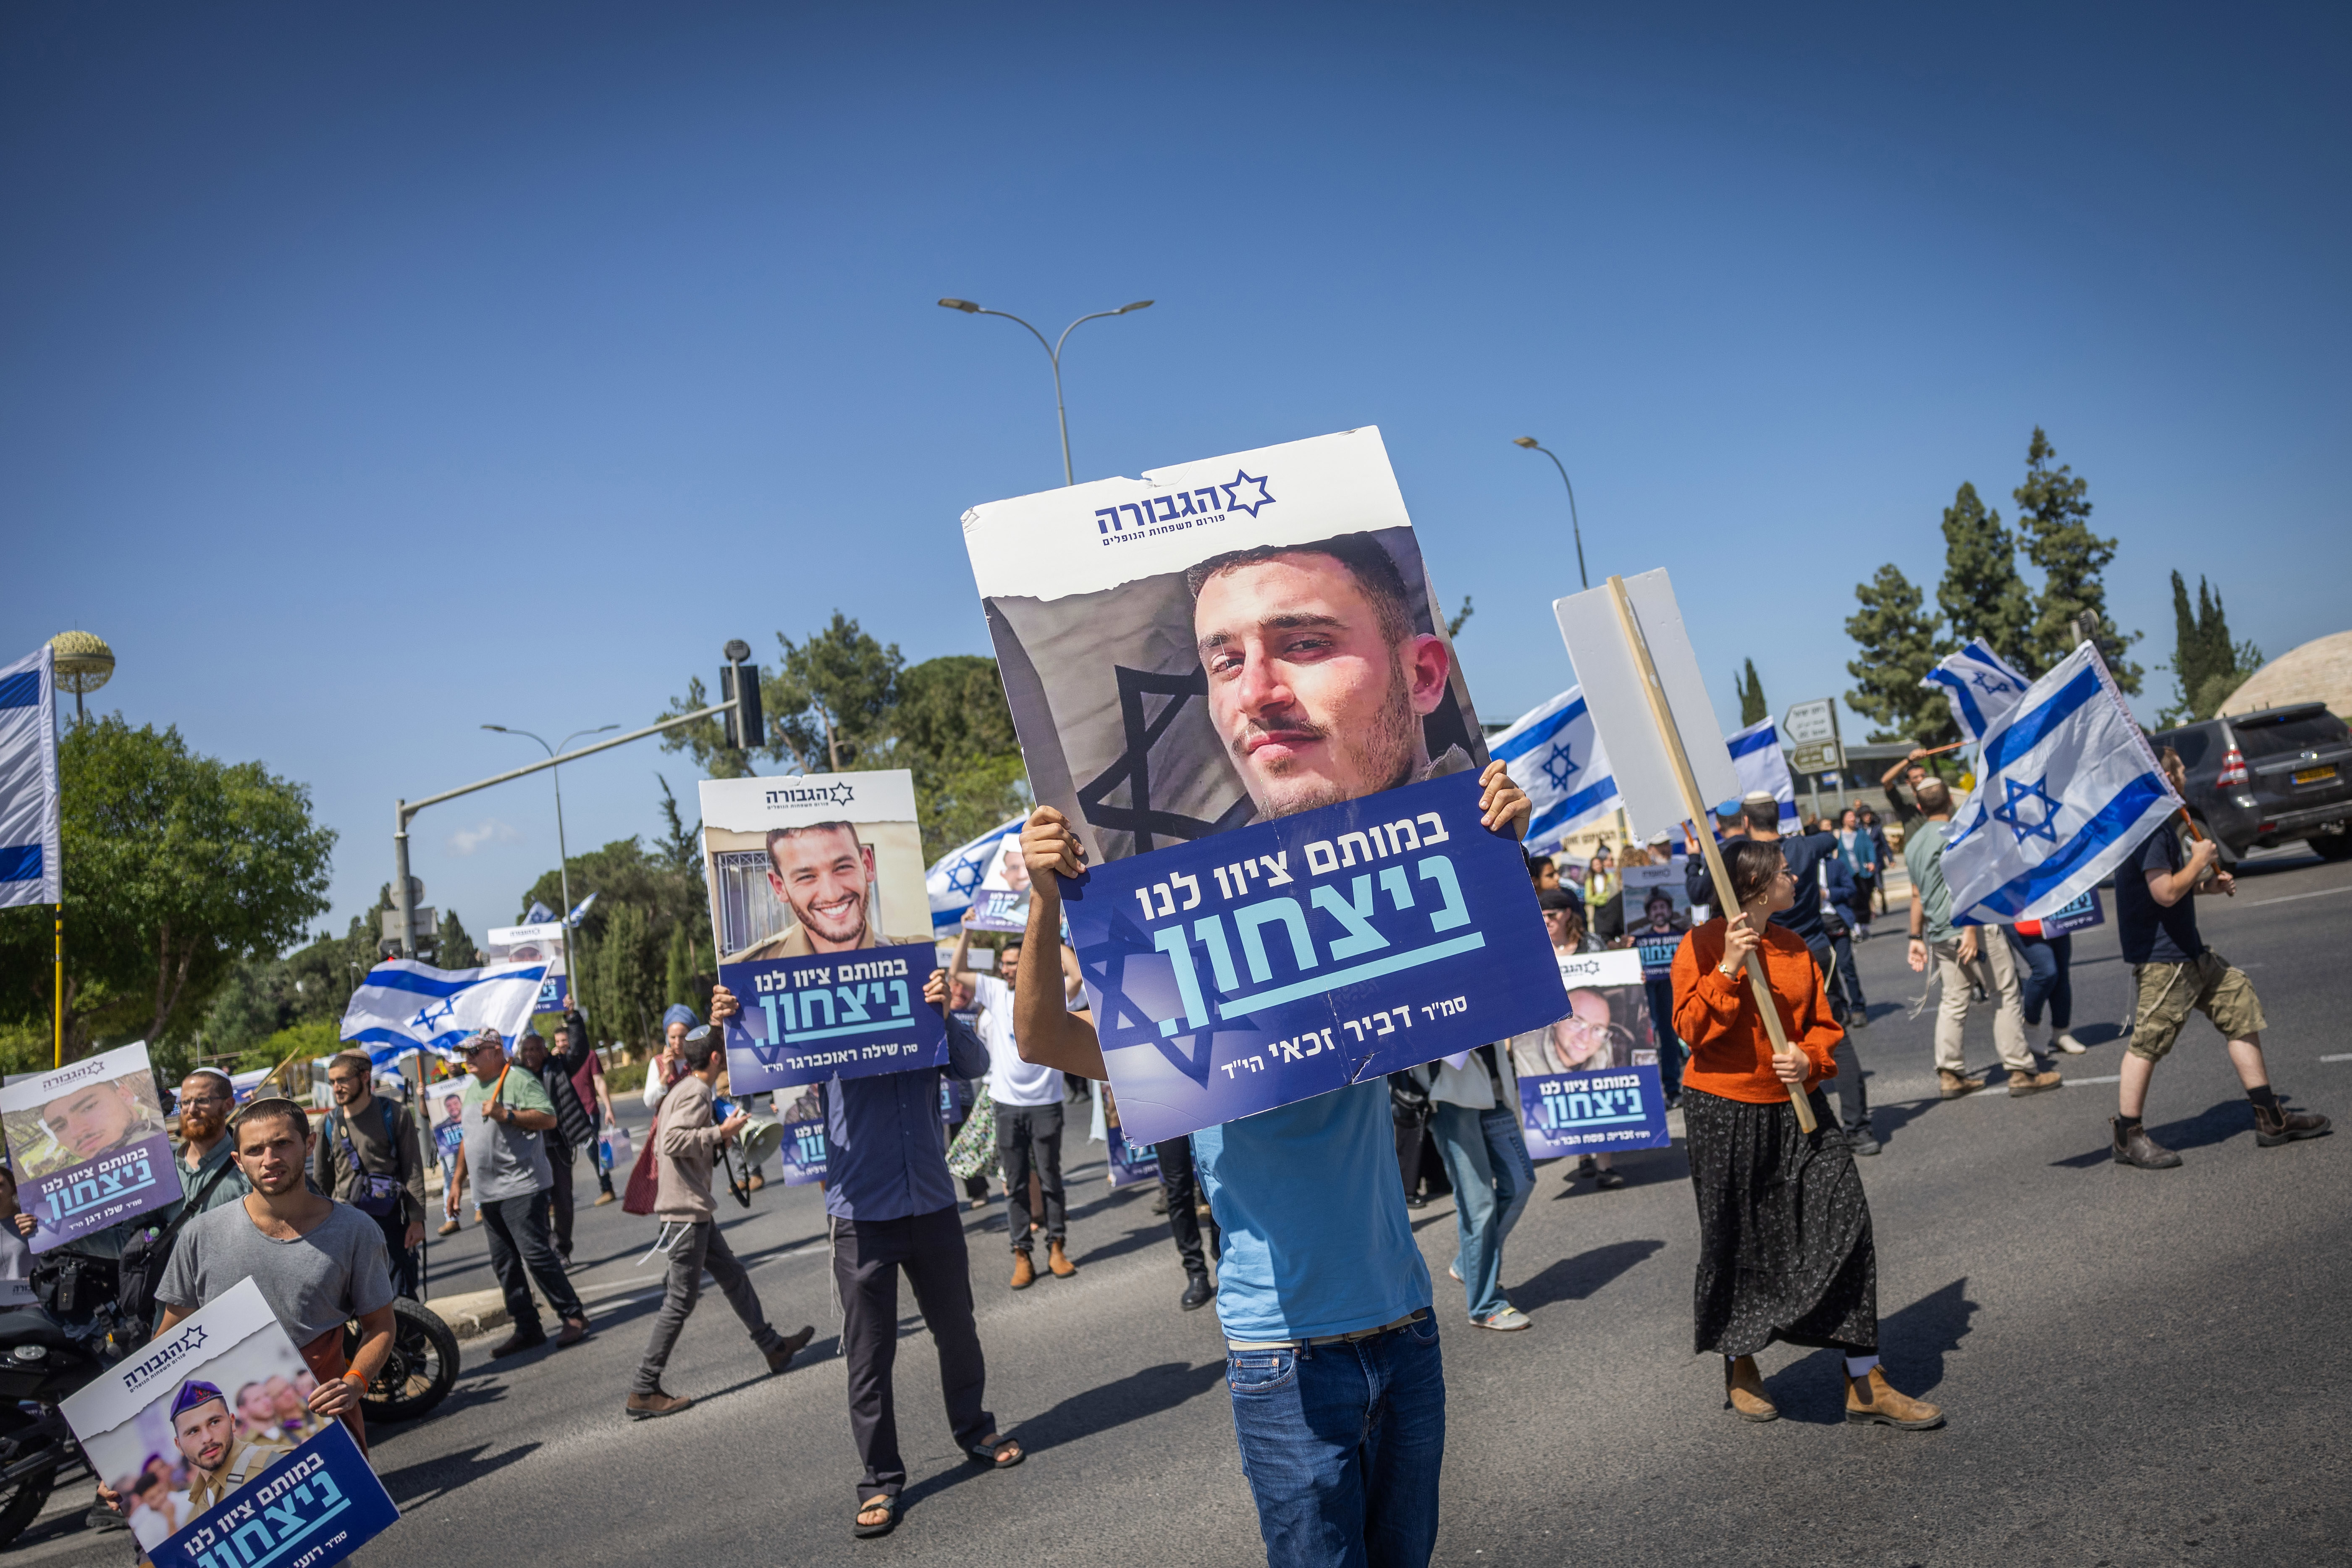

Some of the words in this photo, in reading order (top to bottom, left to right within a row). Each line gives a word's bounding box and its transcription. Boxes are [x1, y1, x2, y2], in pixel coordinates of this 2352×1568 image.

[1095, 486, 1221, 534] הגבורה
[1196, 514, 1225, 526] פורום
[1102, 530, 1145, 546] הנופלים
[1149, 521, 1193, 536] משפחות
[766, 788, 828, 803] הגבורה
[1304, 811, 1449, 875] במותם
[1214, 850, 1293, 899] ציוו
[1135, 872, 1201, 920] לנו
[1153, 854, 1471, 1038] ניצחון.
[755, 970, 787, 992] לנו
[793, 967, 831, 988] ציוו
[838, 958, 908, 983] במותם
[755, 979, 911, 1047] ניצחון.
[1421, 996, 1467, 1023] סמ"ר
[1344, 1005, 1412, 1041] דביר
[862, 1043, 898, 1059] שילה
[902, 1044, 918, 1056] סרן
[1268, 1028, 1335, 1063] זכאי
[762, 1062, 783, 1073] הי"ד
[787, 1049, 857, 1070] ראוכברגר
[1221, 1055, 1264, 1079] הי"ד
[43, 1068, 86, 1088] הגבורה
[1539, 1080, 1561, 1095] לנו
[1563, 1079, 1589, 1093] ציוו
[1592, 1074, 1641, 1091] במותם
[1541, 1088, 1643, 1130] ניצחון.
[98, 1147, 148, 1173] במותם
[41, 1177, 63, 1194] לנו
[67, 1166, 94, 1184] ציוו
[45, 1159, 152, 1225] ניצחון.
[104, 1204, 123, 1218] שלו
[126, 1198, 142, 1209] סמ"ר
[85, 1212, 101, 1226] דגן
[123, 1341, 183, 1388] הגבורה
[172, 1353, 186, 1364] פורום
[150, 1363, 170, 1379] משפחות
[130, 1378, 149, 1393] הנופלים
[256, 1452, 325, 1506] במותם
[217, 1499, 255, 1533] ציוו
[184, 1526, 215, 1556] לנו
[325, 1530, 348, 1549] סמ"ר
